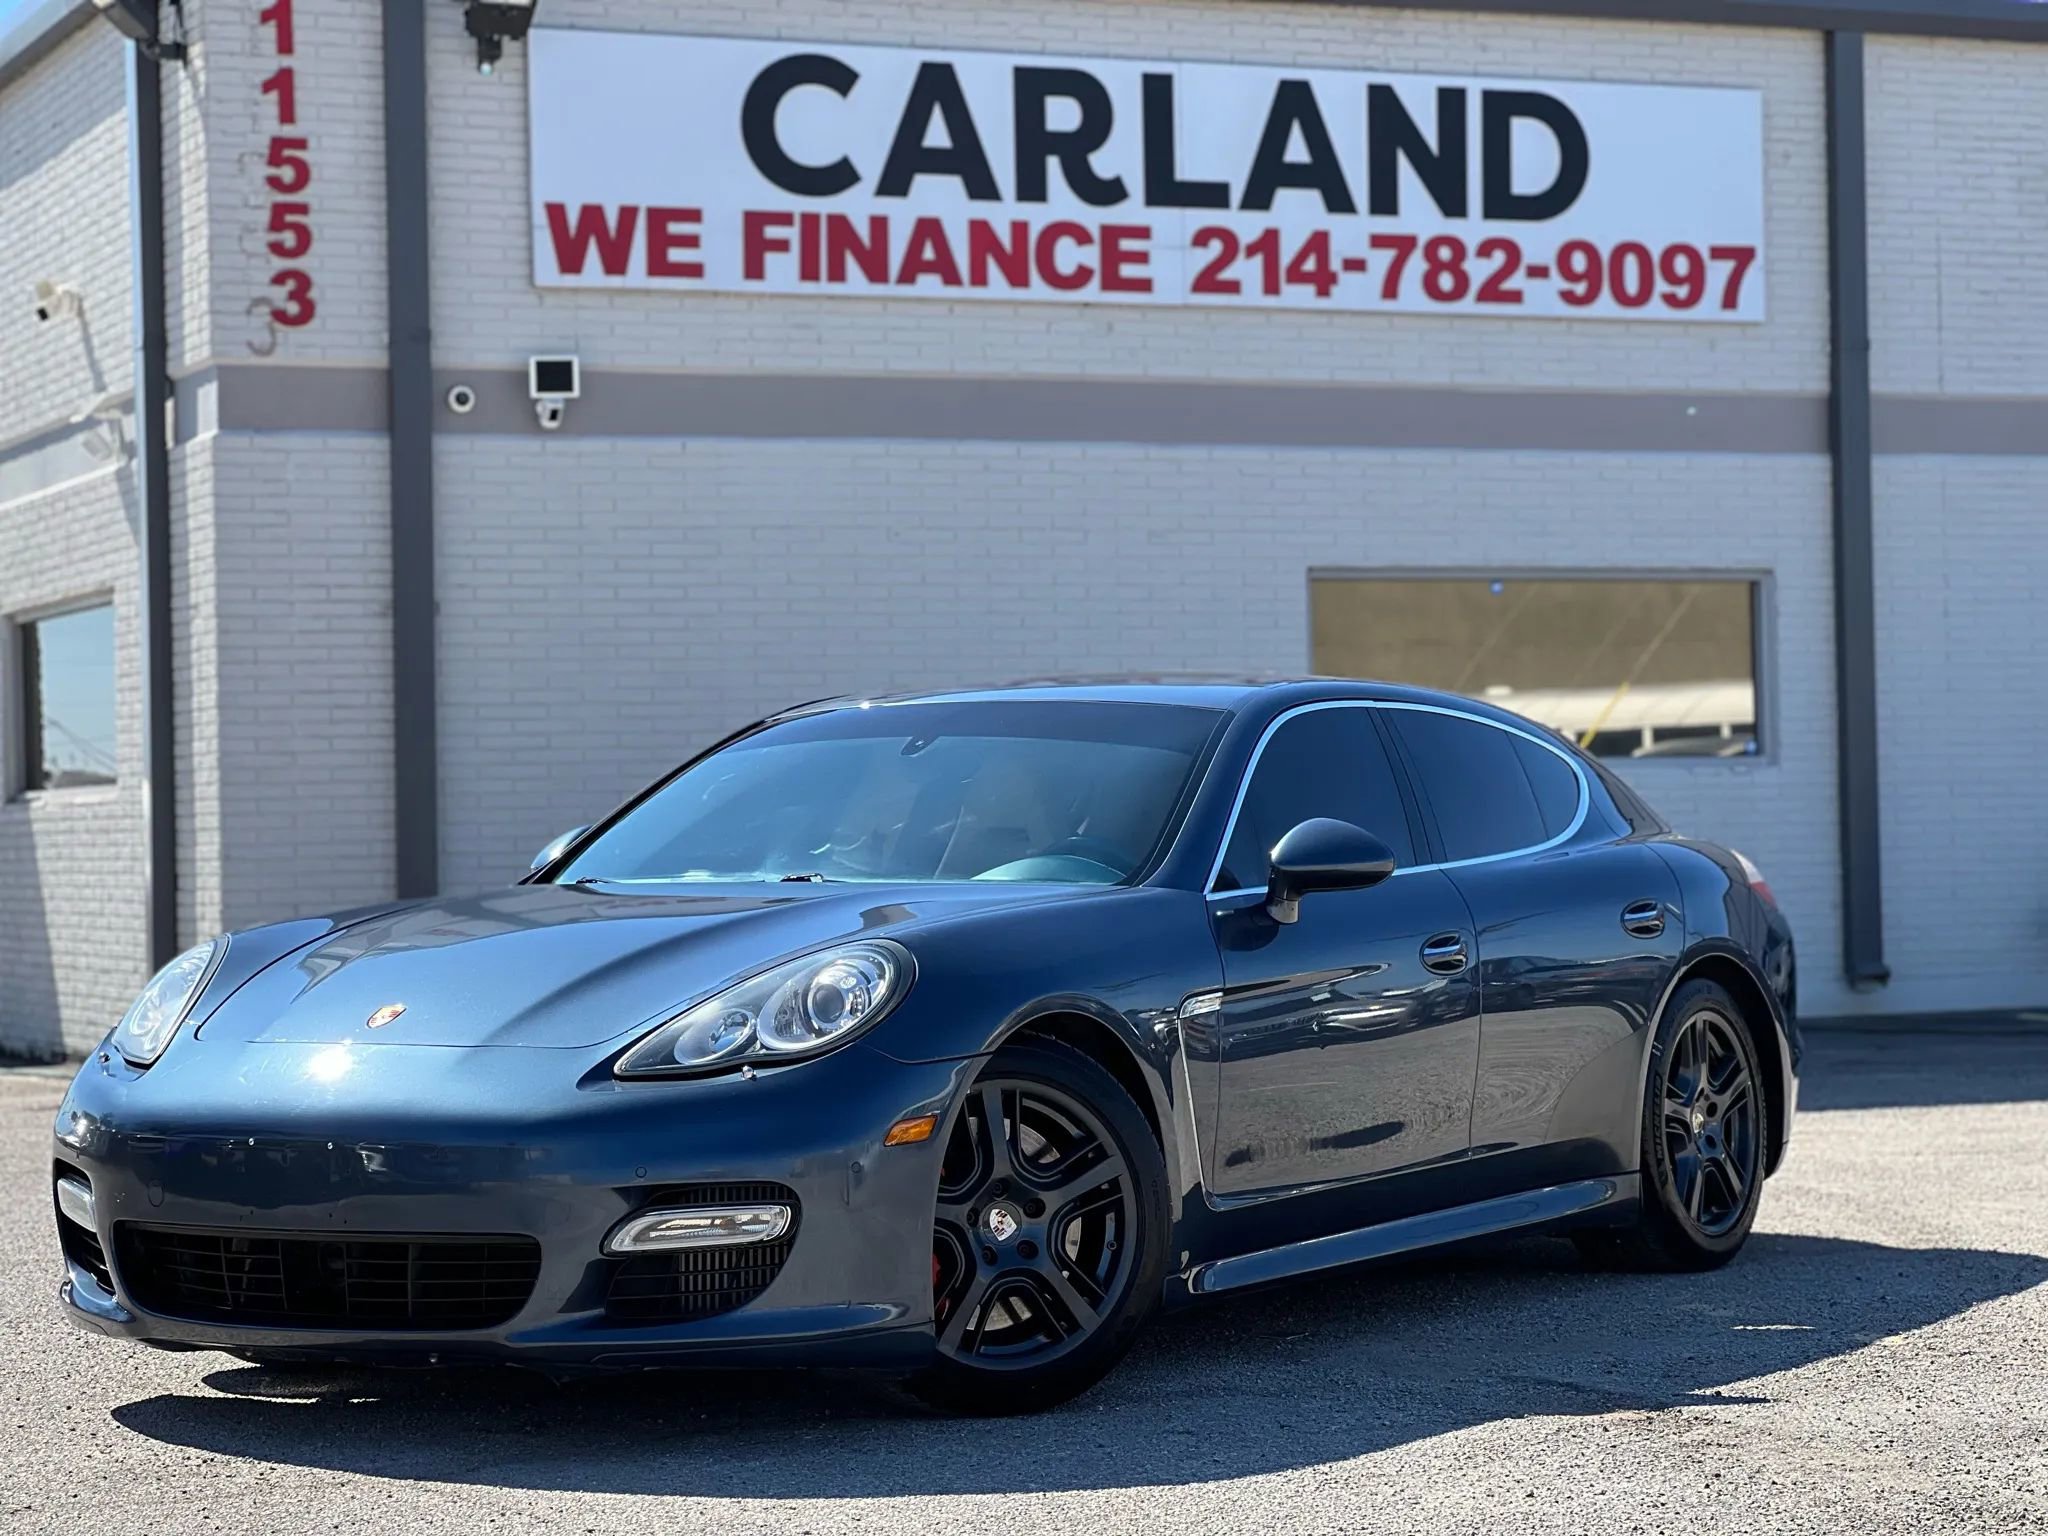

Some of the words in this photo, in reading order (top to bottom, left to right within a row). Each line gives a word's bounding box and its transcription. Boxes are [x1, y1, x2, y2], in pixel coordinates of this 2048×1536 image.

[260, 0, 316, 327] 11553
[741, 54, 1590, 222] CARLAND
[546, 202, 704, 279] WE
[745, 211, 1152, 293] FINANCE
[1192, 227, 1755, 310] 214-782-9097
